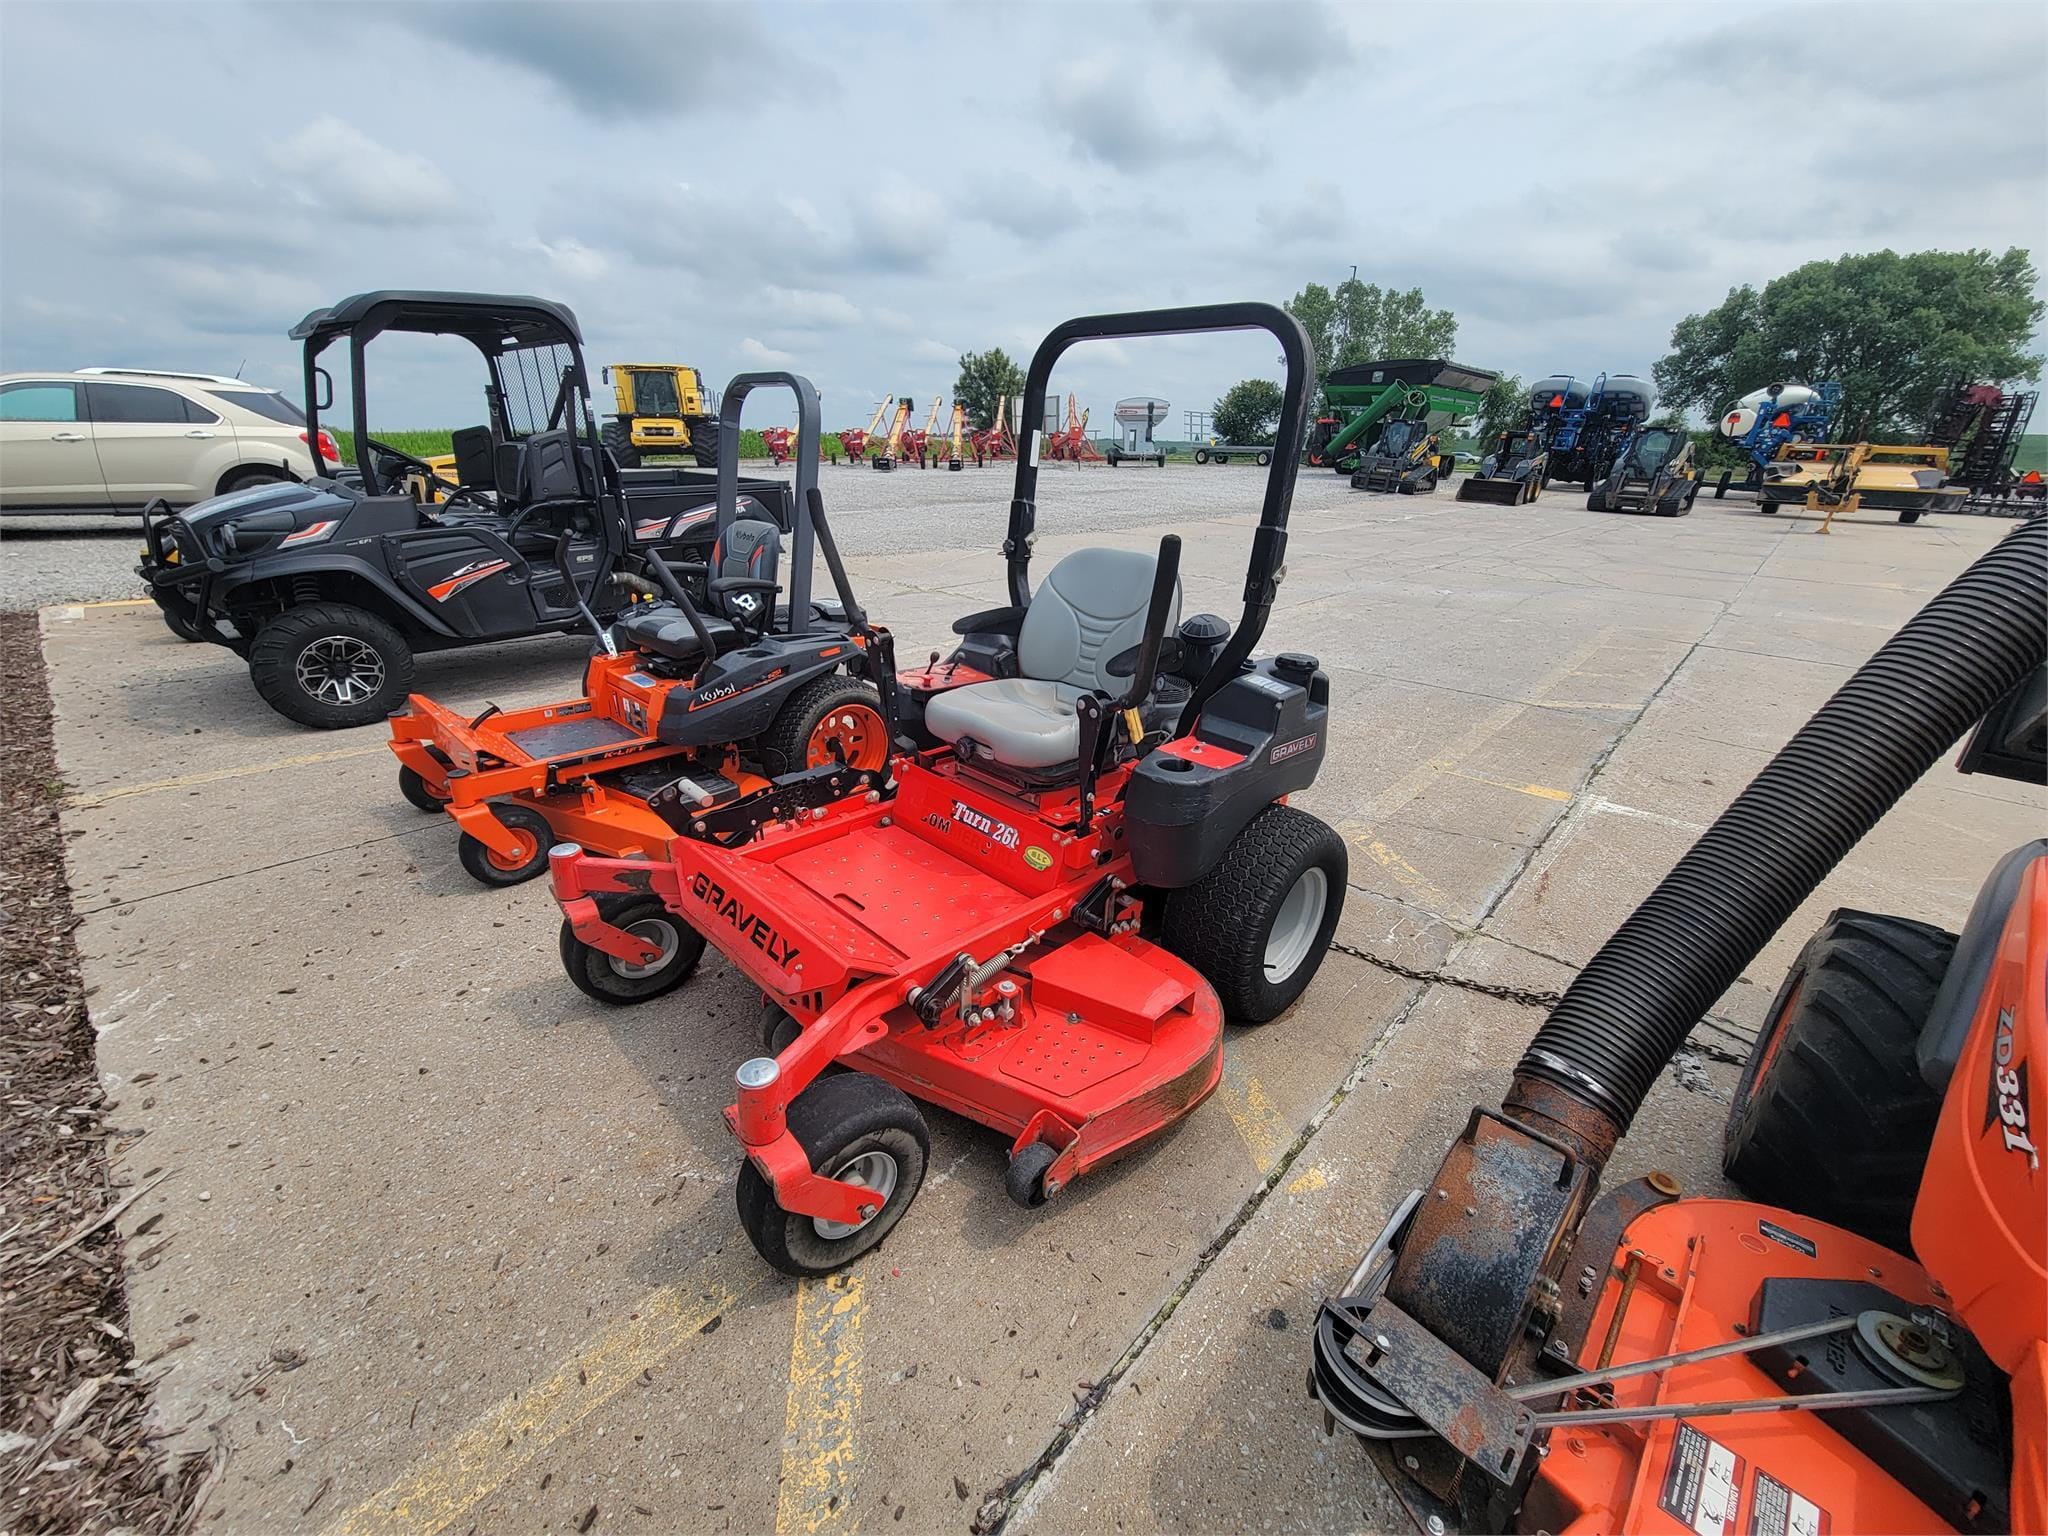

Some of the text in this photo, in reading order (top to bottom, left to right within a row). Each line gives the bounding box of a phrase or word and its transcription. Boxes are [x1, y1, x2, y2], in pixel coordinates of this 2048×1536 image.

[699, 682, 736, 702] Kubot
[1272, 735, 1315, 761] GRAVELY
[953, 801, 991, 833] Turn
[692, 871, 801, 969] GRAVELY
[1996, 1005, 2039, 1169] ZD331
[1726, 1490, 1740, 1522] DANGER
